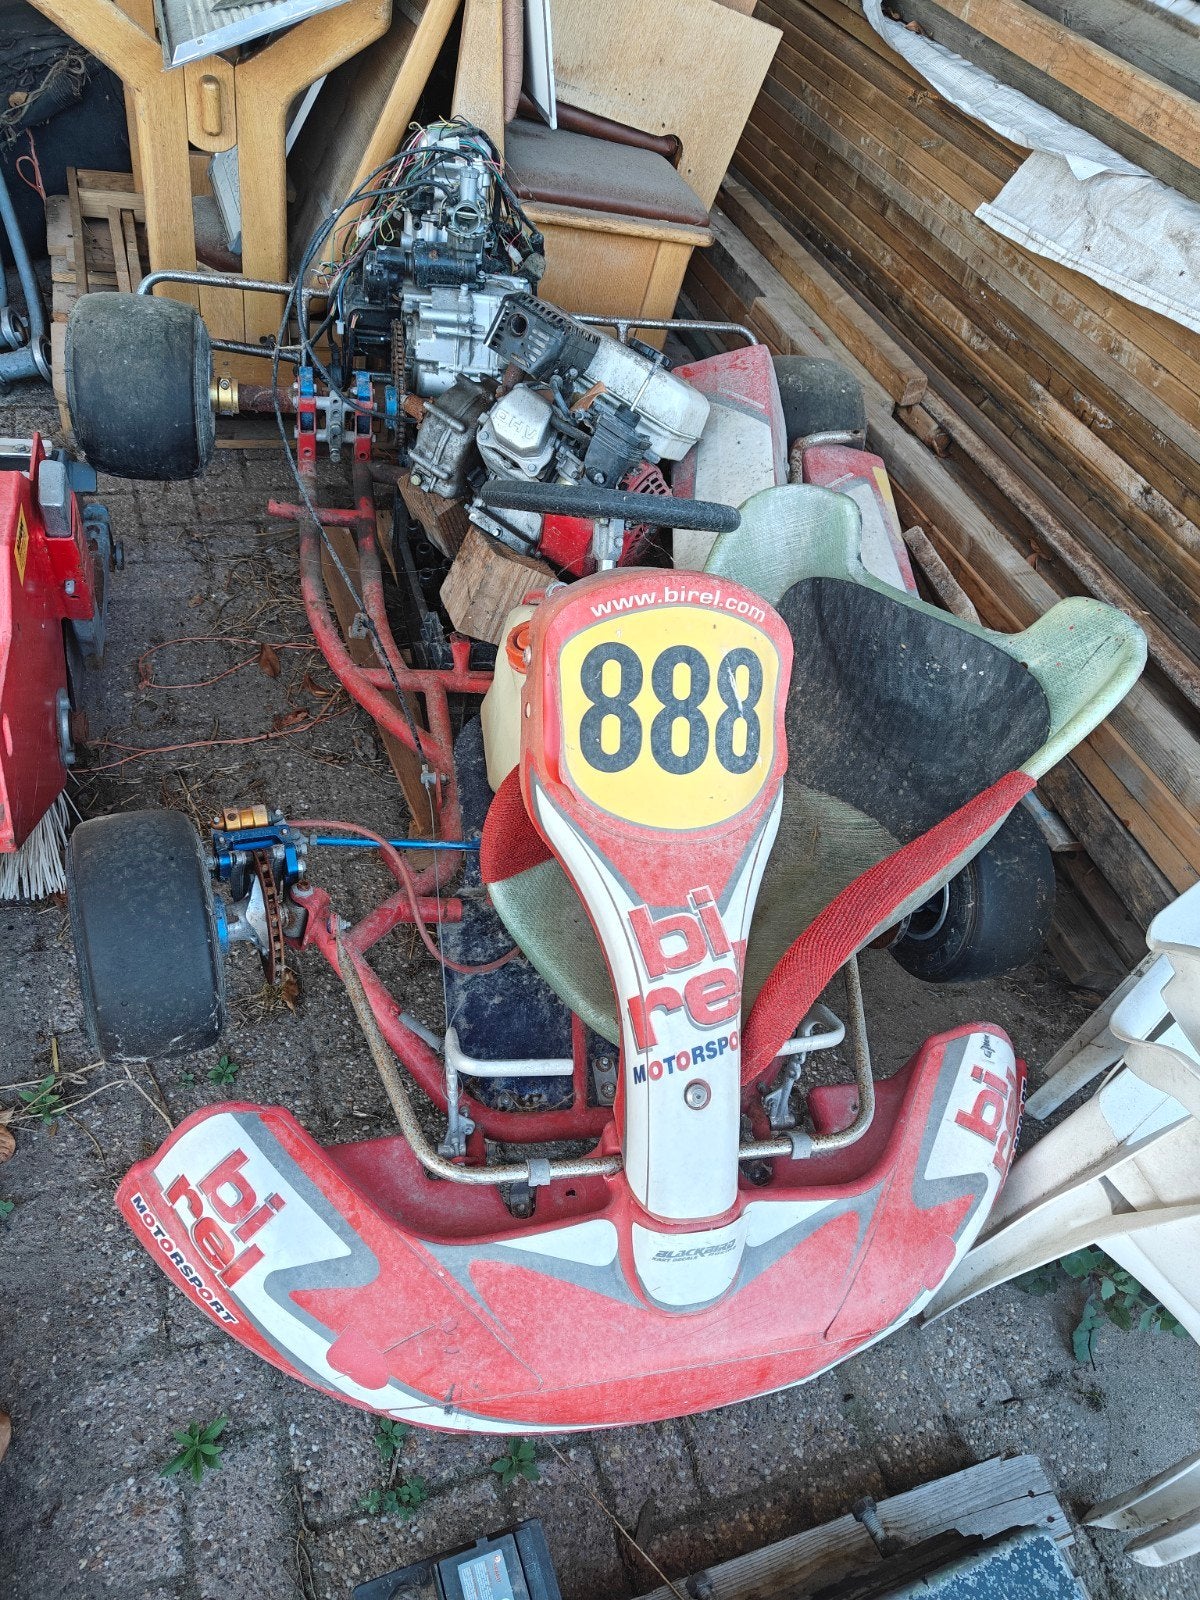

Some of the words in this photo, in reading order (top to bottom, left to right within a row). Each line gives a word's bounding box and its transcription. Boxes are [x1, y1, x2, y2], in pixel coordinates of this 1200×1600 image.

[590, 586, 766, 622] www.birel.com
[579, 641, 764, 775] 888
[627, 885, 732, 982] bi
[197, 1147, 286, 1244] bi
[131, 1193, 238, 1324] MOTORSPORT
